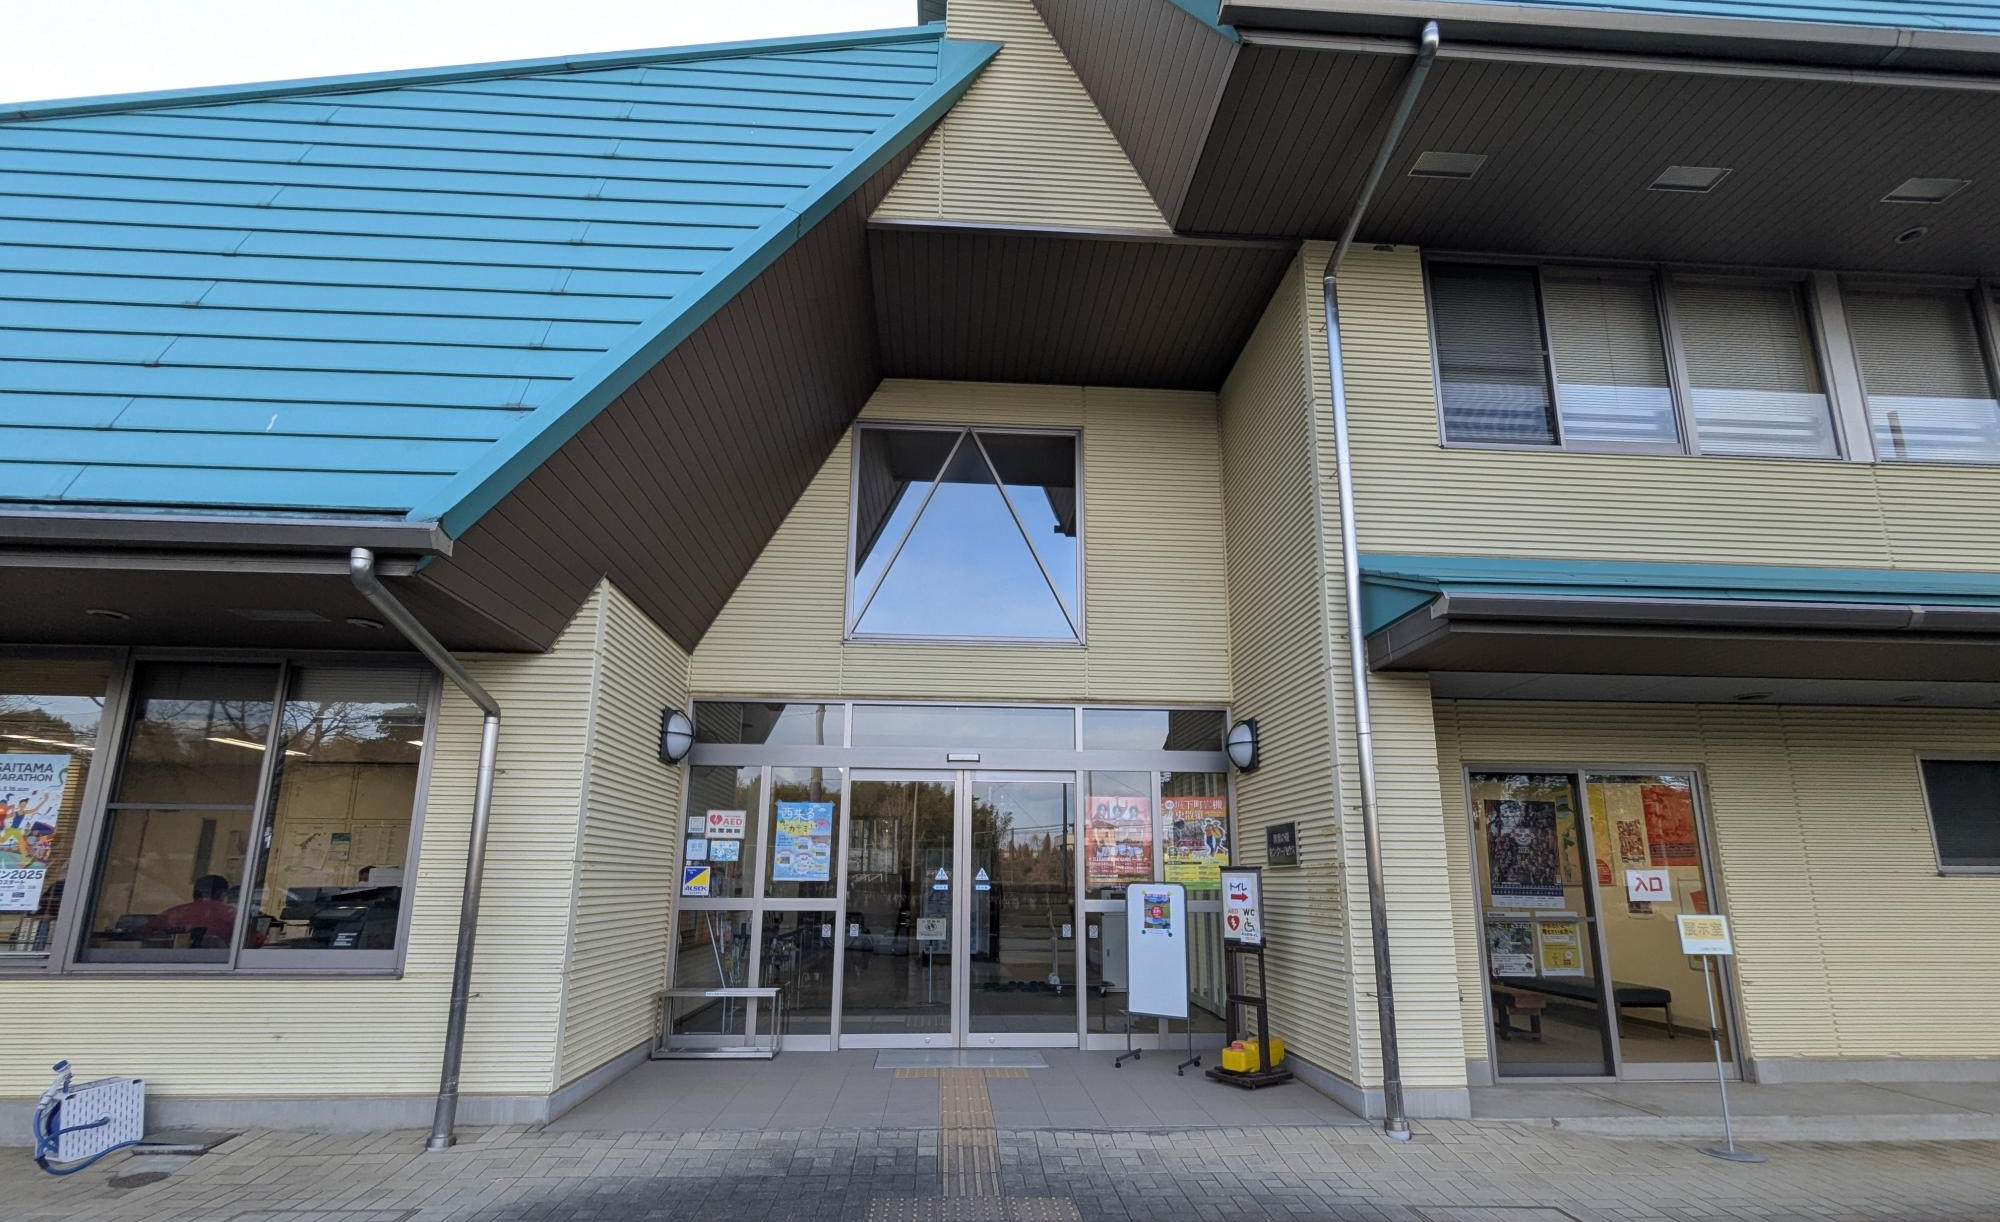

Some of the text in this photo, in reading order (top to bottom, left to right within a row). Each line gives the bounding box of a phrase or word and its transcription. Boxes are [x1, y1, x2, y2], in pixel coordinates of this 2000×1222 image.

[0, 773, 53, 782] ARATHON
[1635, 876, 1664, 892] 入口
[1243, 908, 1255, 917] WC
